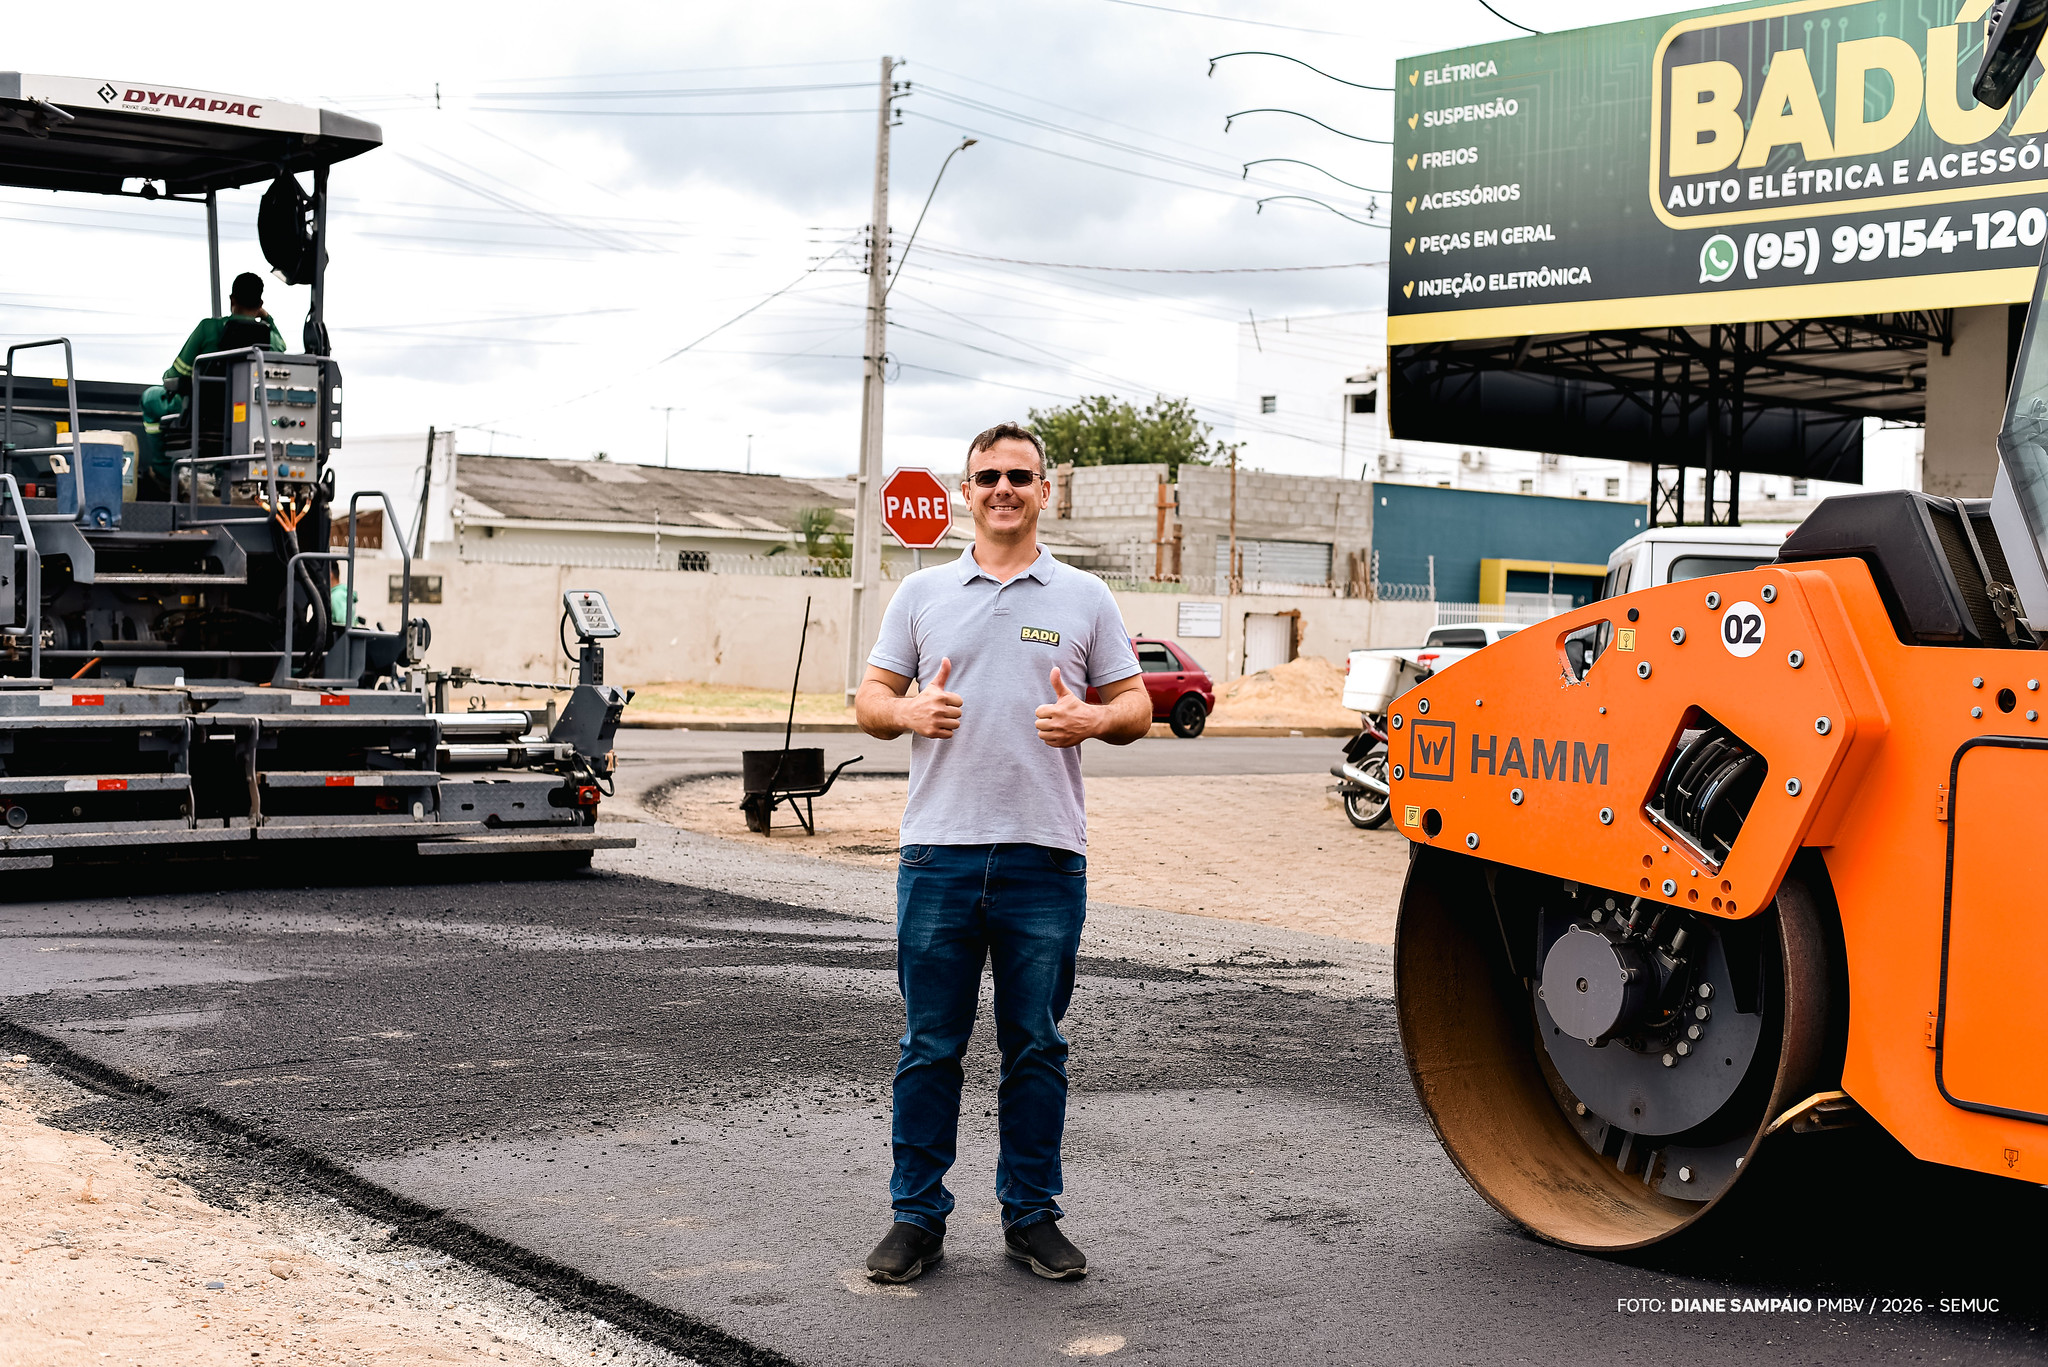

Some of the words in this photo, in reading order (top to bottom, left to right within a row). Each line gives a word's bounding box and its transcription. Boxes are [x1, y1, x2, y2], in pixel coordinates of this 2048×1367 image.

[1423, 60, 1498, 86] ELÉTRICA
[122, 89, 263, 118] DYNAPAC
[1423, 97, 1518, 127] SUSPENSÃO
[1422, 146, 1478, 169] FREIOS
[1667, 178, 1741, 209] AUTO
[1748, 162, 1884, 200] ELÉTRICA
[1893, 159, 1909, 185] E
[1917, 137, 2048, 182] ACESSÓ
[1420, 183, 1521, 211] ACESSÓRIOS
[1420, 232, 1471, 255] PEÇAS
[1474, 229, 1498, 248] EM
[1501, 224, 1556, 245] GERAL
[1743, 227, 1820, 280] (95)
[1831, 207, 2048, 264] 99154-120
[1418, 272, 1486, 298] INJEÇÃO
[1488, 265, 1592, 292] ELETRÔNICA
[886, 496, 946, 519] PARE
[1724, 614, 1761, 644] 02
[1471, 734, 1609, 785] HAMM
